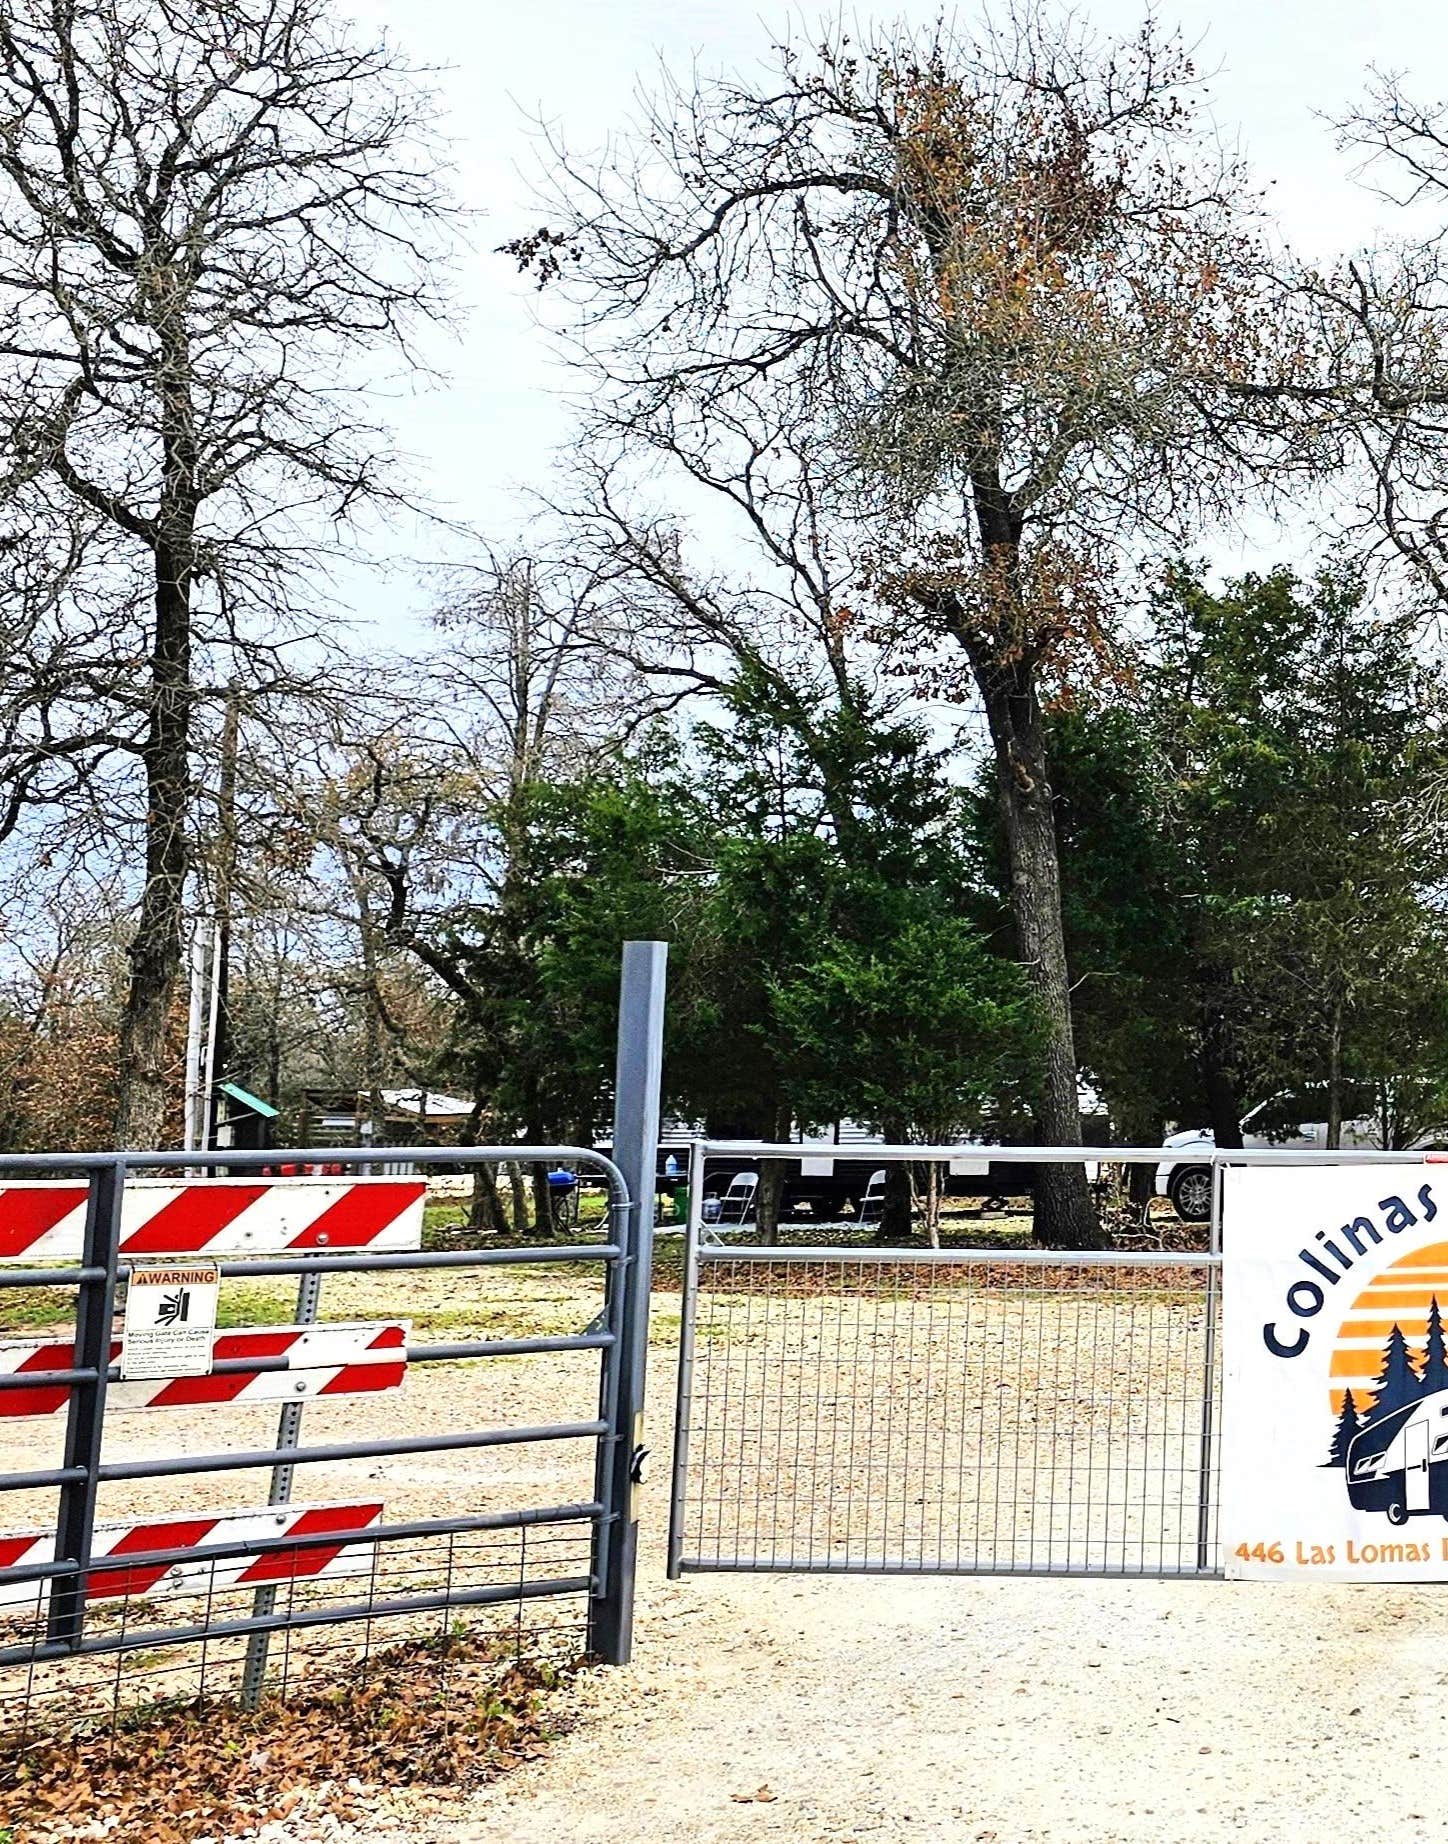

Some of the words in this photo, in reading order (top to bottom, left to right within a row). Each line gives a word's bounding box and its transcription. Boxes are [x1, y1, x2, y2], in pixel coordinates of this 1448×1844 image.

[148, 1271, 215, 1285] WARNING
[1263, 1183, 1438, 1358] Colinas
[1234, 1540, 1285, 1565] 446
[1295, 1540, 1336, 1565] Las
[1346, 1539, 1431, 1564] Lomas
